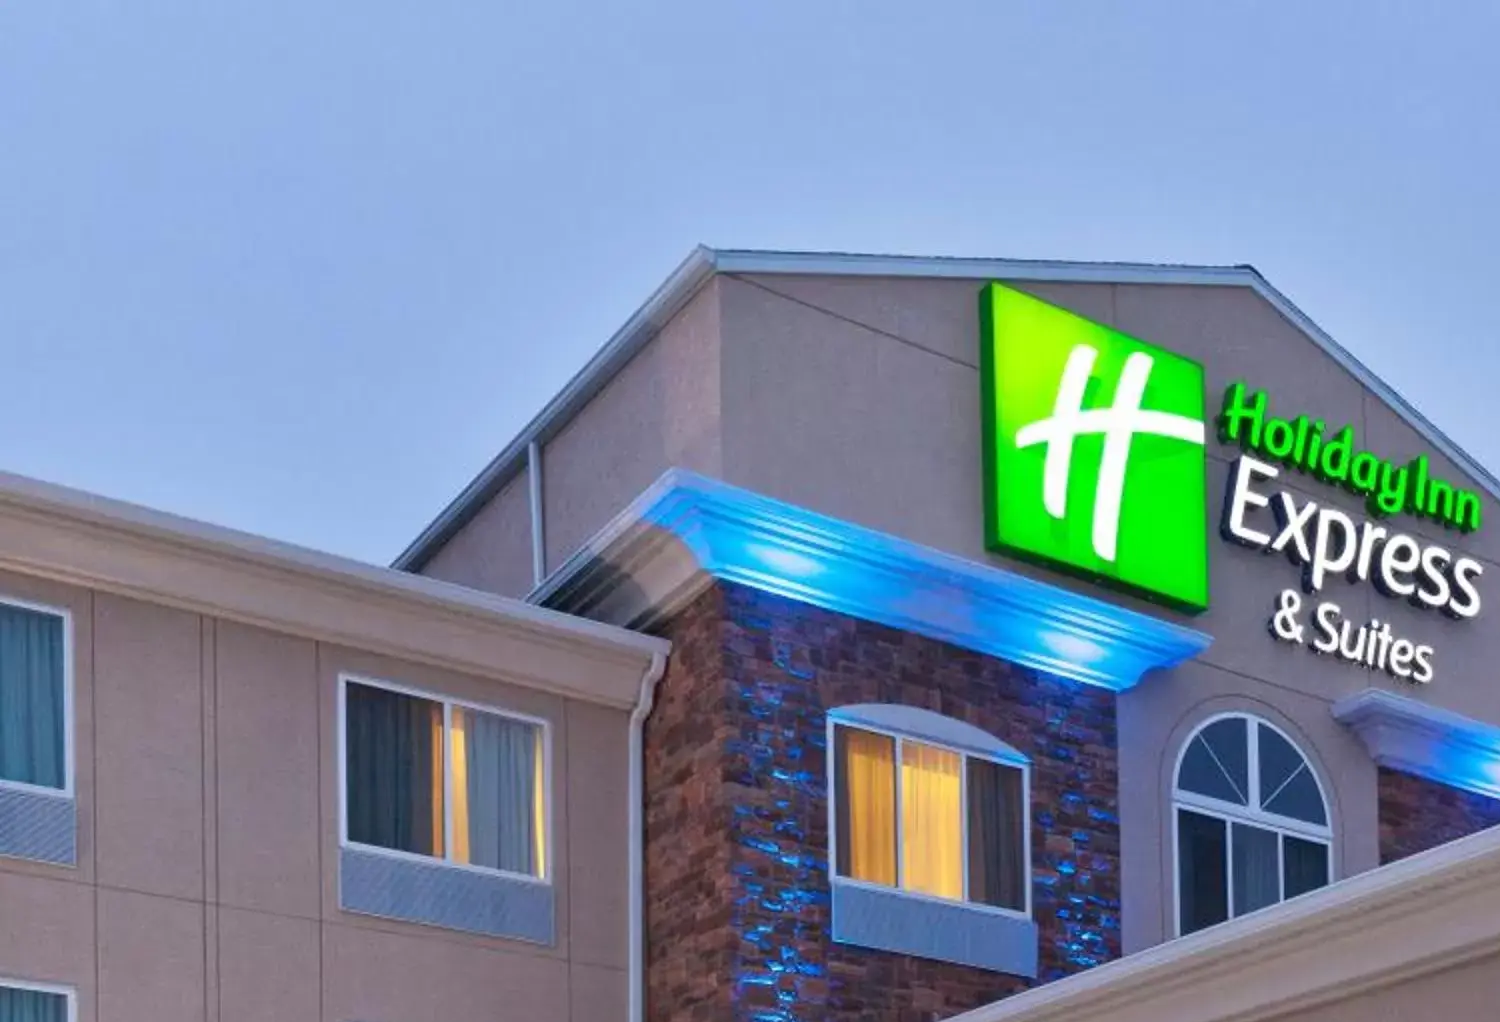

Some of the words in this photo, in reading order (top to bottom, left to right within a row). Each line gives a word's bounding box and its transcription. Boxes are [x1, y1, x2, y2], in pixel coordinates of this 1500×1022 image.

[1220, 382, 1408, 514] Holiday
[1416, 456, 1482, 532] Inn
[1225, 454, 1484, 619] Express
[1271, 588, 1303, 642] &
[1313, 603, 1435, 684] Suites
